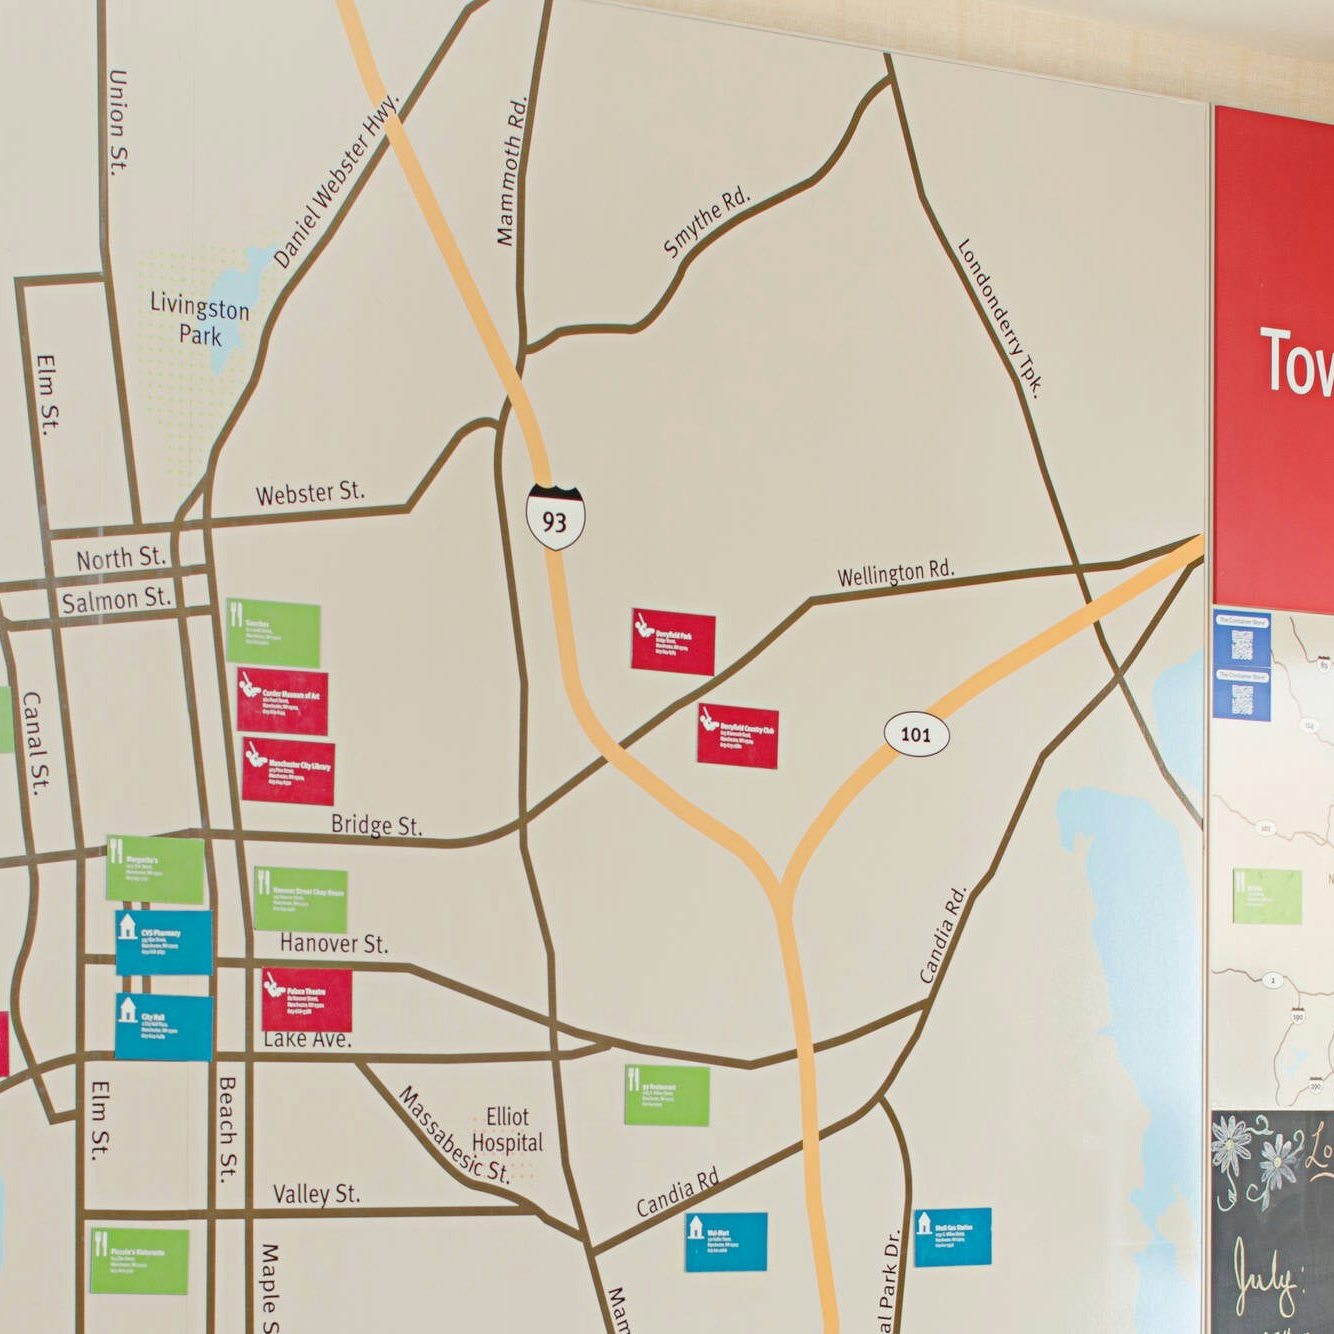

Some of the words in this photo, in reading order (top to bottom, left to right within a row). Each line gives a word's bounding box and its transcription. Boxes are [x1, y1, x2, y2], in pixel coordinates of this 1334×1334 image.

[508, 95, 528, 127] Rd.
[273, 206, 322, 270] Daniel
[313, 136, 370, 212] Webster
[362, 94, 400, 138] Hwy.
[497, 130, 523, 246] Mammoth
[663, 202, 722, 259] Smythe
[720, 186, 751, 214] Rd.
[150, 290, 251, 322] Livingston
[958, 237, 1023, 357] Londonderry
[1018, 351, 1041, 400] Tpk.
[178, 323, 223, 348] Park
[256, 483, 333, 506] Webster
[340, 480, 365, 500] St.
[542, 511, 568, 533] 93
[838, 562, 924, 588] Wellington
[928, 557, 955, 579] Rd.
[900, 726, 932, 743] 101
[331, 814, 392, 839] Bridge
[398, 816, 423, 837] St.
[280, 932, 358, 954] Hanover
[363, 934, 388, 954] St.
[486, 1107, 529, 1127] Elliot
[400, 1085, 483, 1178] Massabesic
[487, 1161, 510, 1185] St.
[472, 1132, 543, 1153] Hospital
[884, 1229, 901, 1256] Dr.
[879, 1261, 898, 1309] Park
